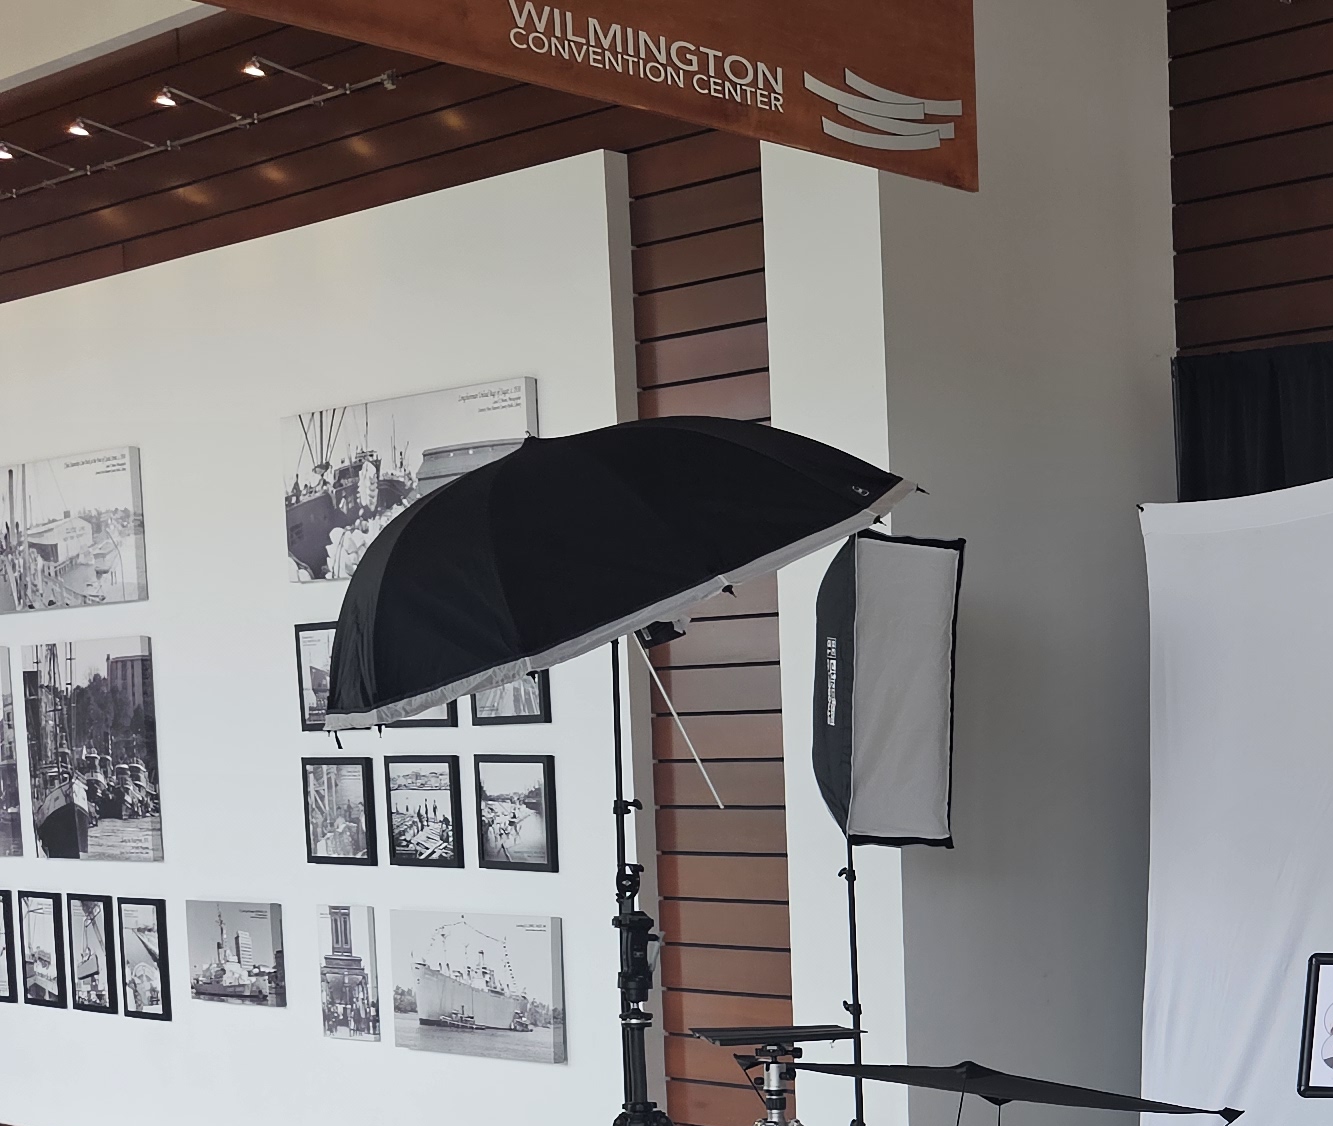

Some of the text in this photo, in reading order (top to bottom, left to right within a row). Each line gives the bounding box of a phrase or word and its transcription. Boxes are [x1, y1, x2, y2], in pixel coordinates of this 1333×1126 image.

[508, 0, 784, 94] WILMINGTON
[509, 28, 784, 113] CONVENTION CENTER
